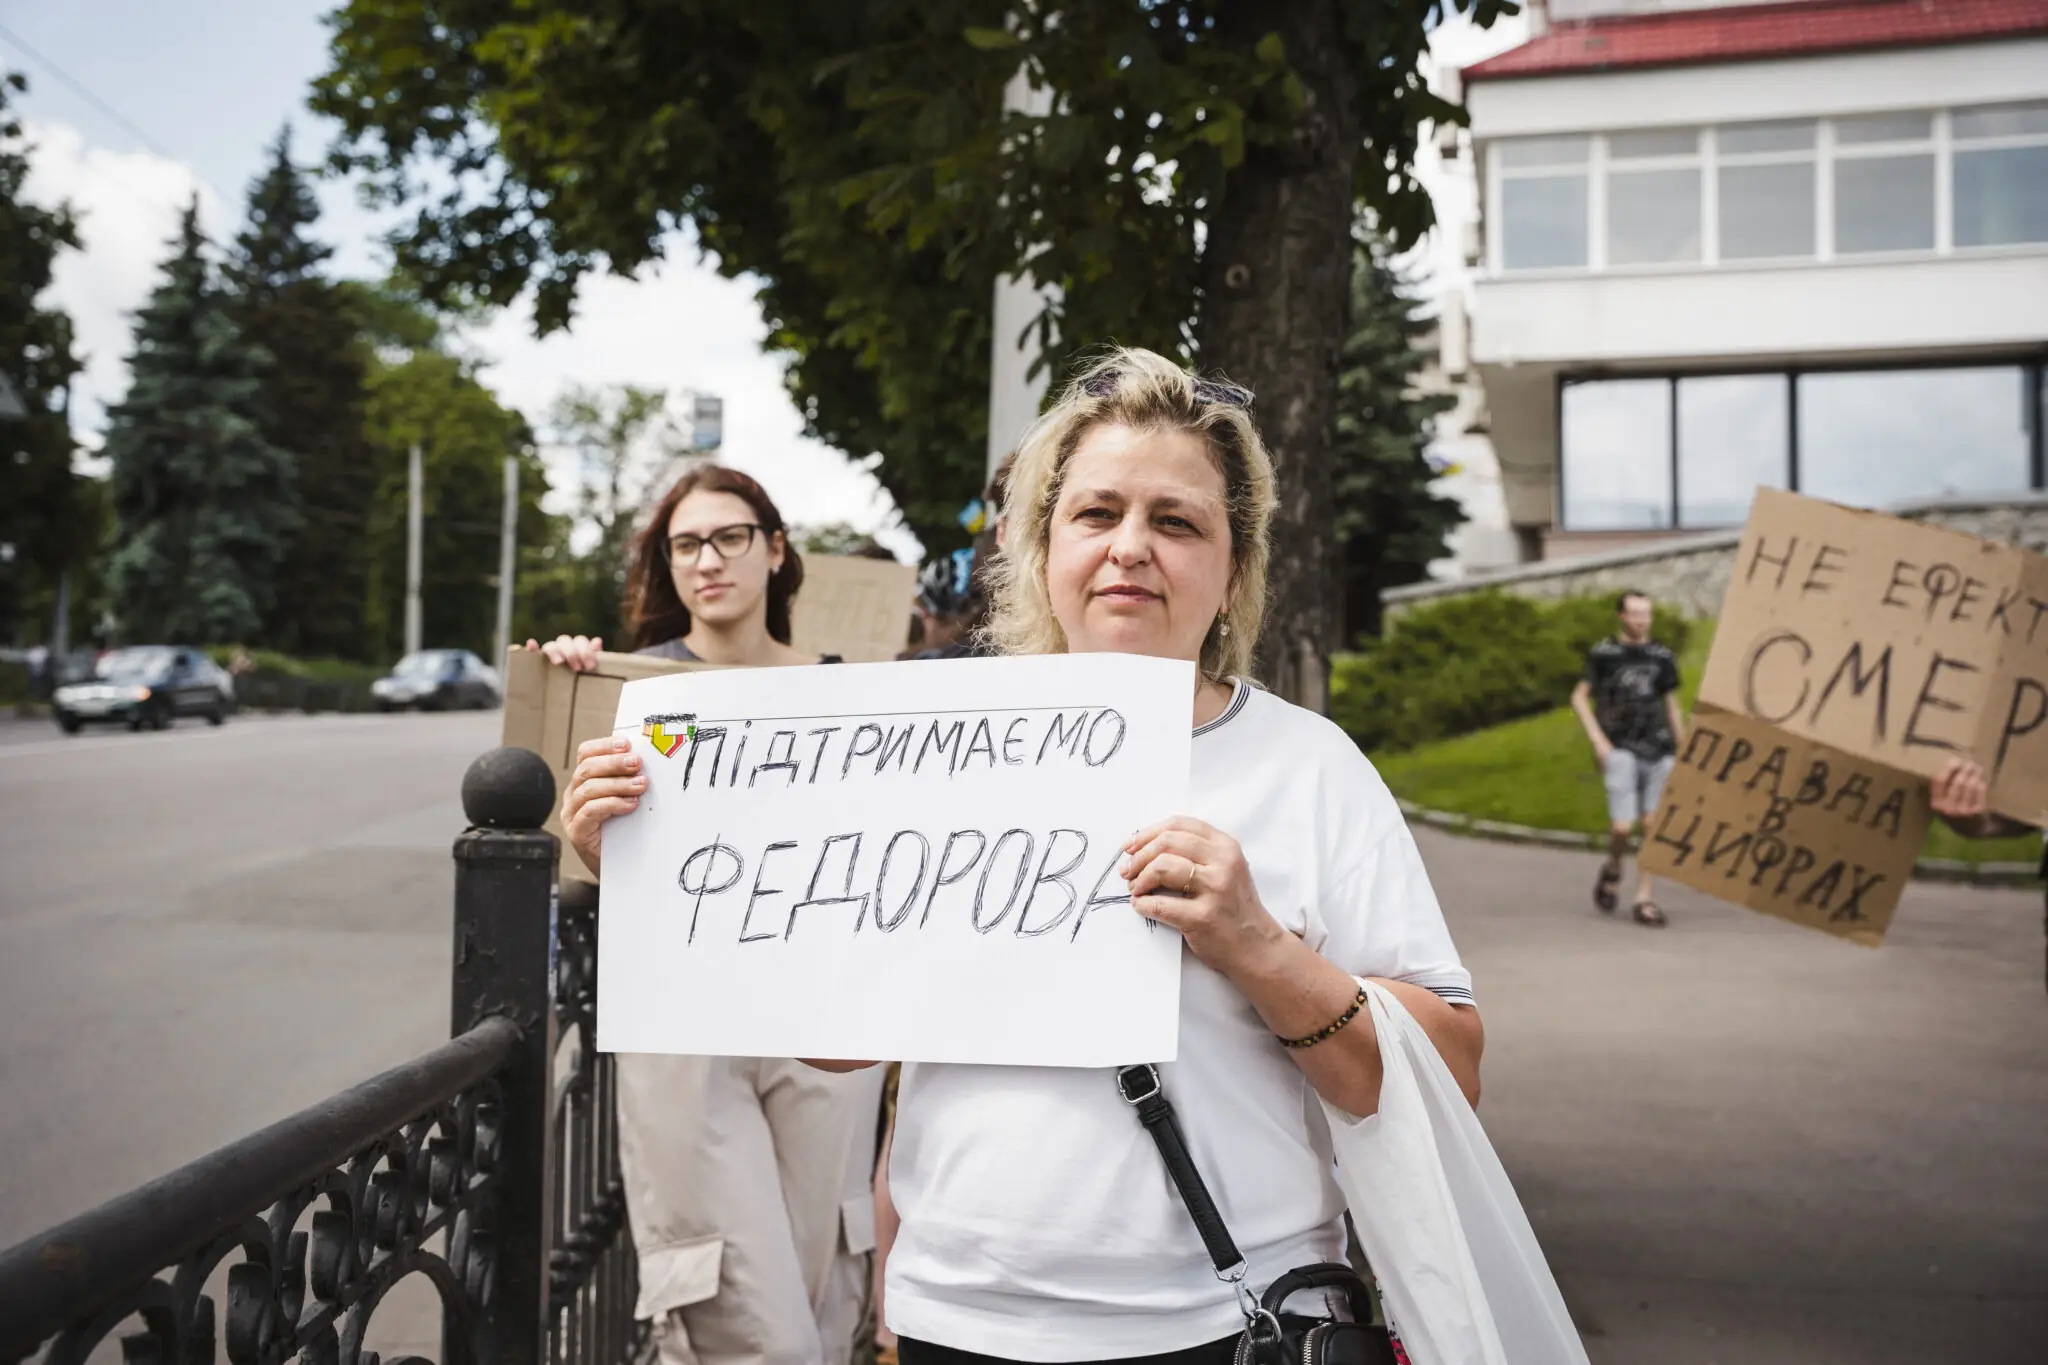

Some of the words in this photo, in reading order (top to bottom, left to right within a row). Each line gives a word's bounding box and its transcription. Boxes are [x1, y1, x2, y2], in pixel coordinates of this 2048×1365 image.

[1745, 536, 1849, 594] НЕ
[1739, 628, 2048, 784] СМЕР
[1680, 726, 1907, 840] ПРАВДА
[1757, 796, 1795, 835] В
[1654, 803, 1888, 923] ЦИФРАХ
